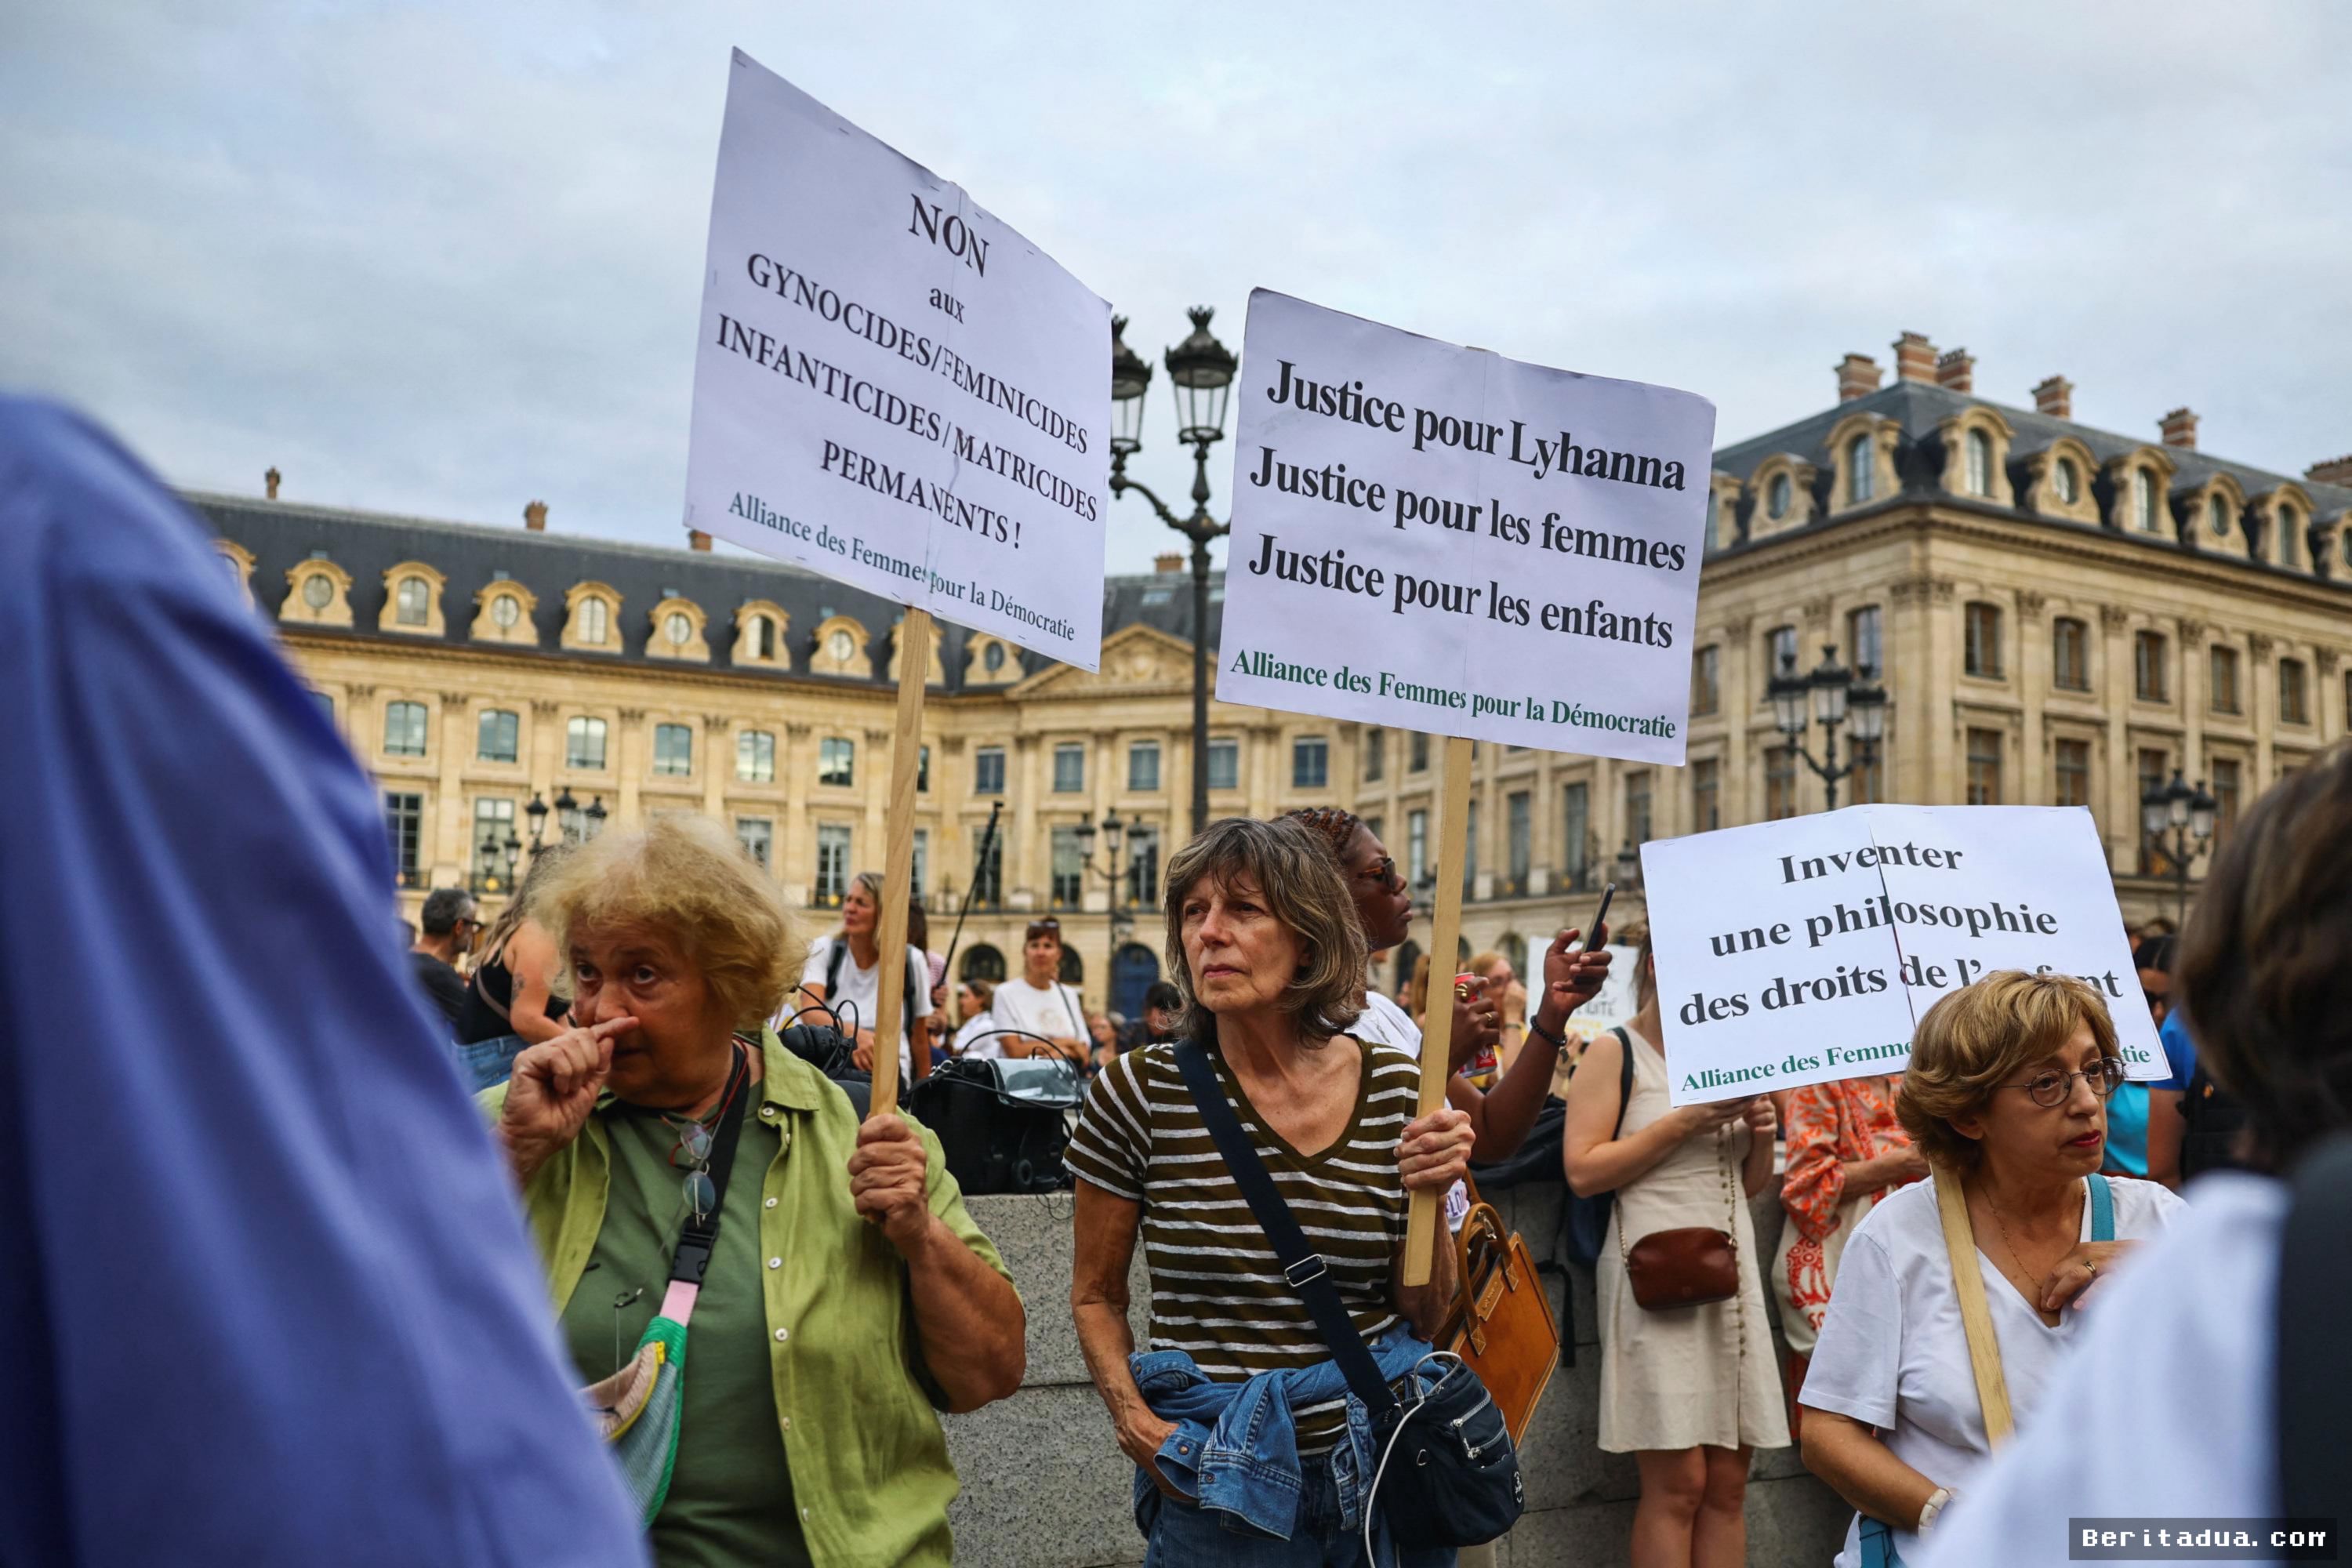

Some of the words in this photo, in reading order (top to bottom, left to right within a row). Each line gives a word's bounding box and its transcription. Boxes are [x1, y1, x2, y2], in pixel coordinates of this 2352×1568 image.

[908, 193, 989, 278] NON
[929, 288, 964, 325] aux
[747, 253, 1087, 454] GYNOCIDES/FEMINICIDES
[1266, 359, 1406, 433] Justice
[1412, 408, 1504, 456] pour
[1508, 419, 1686, 492] Lyhanna
[1250, 445, 1386, 513] Justice
[1393, 488, 1483, 533] pour
[1488, 498, 1530, 546] les
[1540, 512, 1686, 572] femmes
[728, 492, 811, 542] Alliance
[815, 524, 846, 556] des
[970, 581, 985, 607] la
[989, 589, 1075, 641] Démocratie
[1248, 533, 1385, 597] Justice
[1392, 573, 1482, 615] pour
[1487, 580, 1530, 626] les
[1541, 599, 1672, 649] enfants
[1230, 648, 1328, 687] Alliance
[1333, 666, 1371, 694] des
[1377, 671, 1467, 709] Femmes
[1471, 694, 1522, 718] pour
[1526, 696, 1544, 722] la
[1551, 700, 1676, 739] Démocratie
[1778, 841, 1963, 884] Inventer
[1709, 923, 1791, 957] une
[1804, 895, 2059, 949] philosophie
[1679, 991, 1750, 1025] des
[1761, 965, 1888, 1011] droits
[1899, 954, 1948, 994] de
[1681, 1064, 1775, 1091] Alliance
[1781, 1054, 1820, 1074] des
